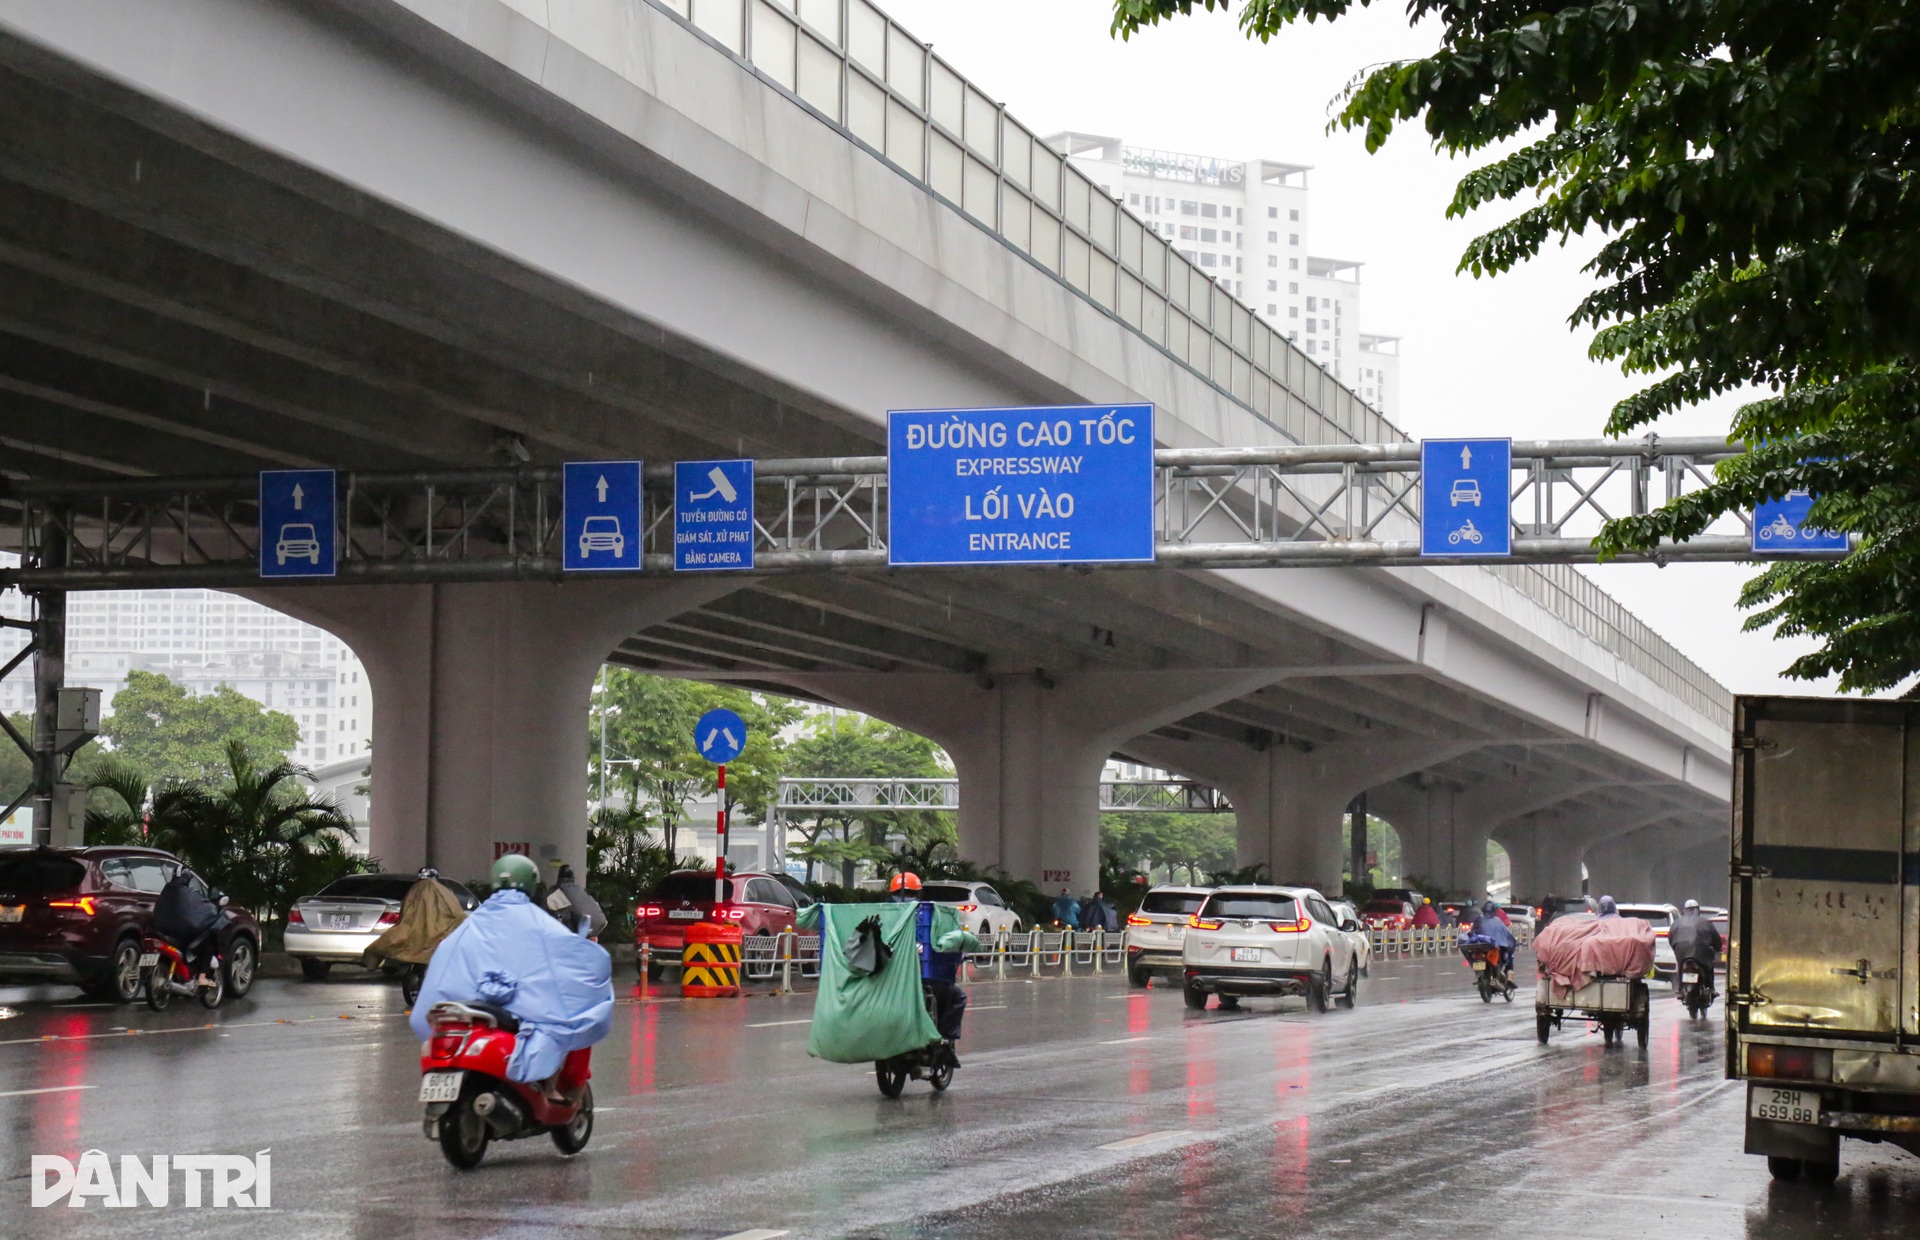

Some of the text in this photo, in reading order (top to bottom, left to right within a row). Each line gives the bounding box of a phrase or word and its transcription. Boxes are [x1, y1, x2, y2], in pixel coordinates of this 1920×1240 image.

[906, 410, 1135, 449] ĐƯỜNG CAO TỐC
[956, 456, 1083, 476] EXPRESSWAY
[965, 485, 1075, 520] LỐI VÀO
[736, 508, 748, 521] CÓ
[677, 530, 697, 543] GIÁM
[729, 531, 750, 543] PHẠT
[969, 532, 1071, 551] ENTRANCE
[708, 552, 741, 563] CAMERA
[1043, 870, 1071, 882] P22
[1772, 1090, 1801, 1105] 29H
[1759, 1104, 1812, 1122] 699.88
